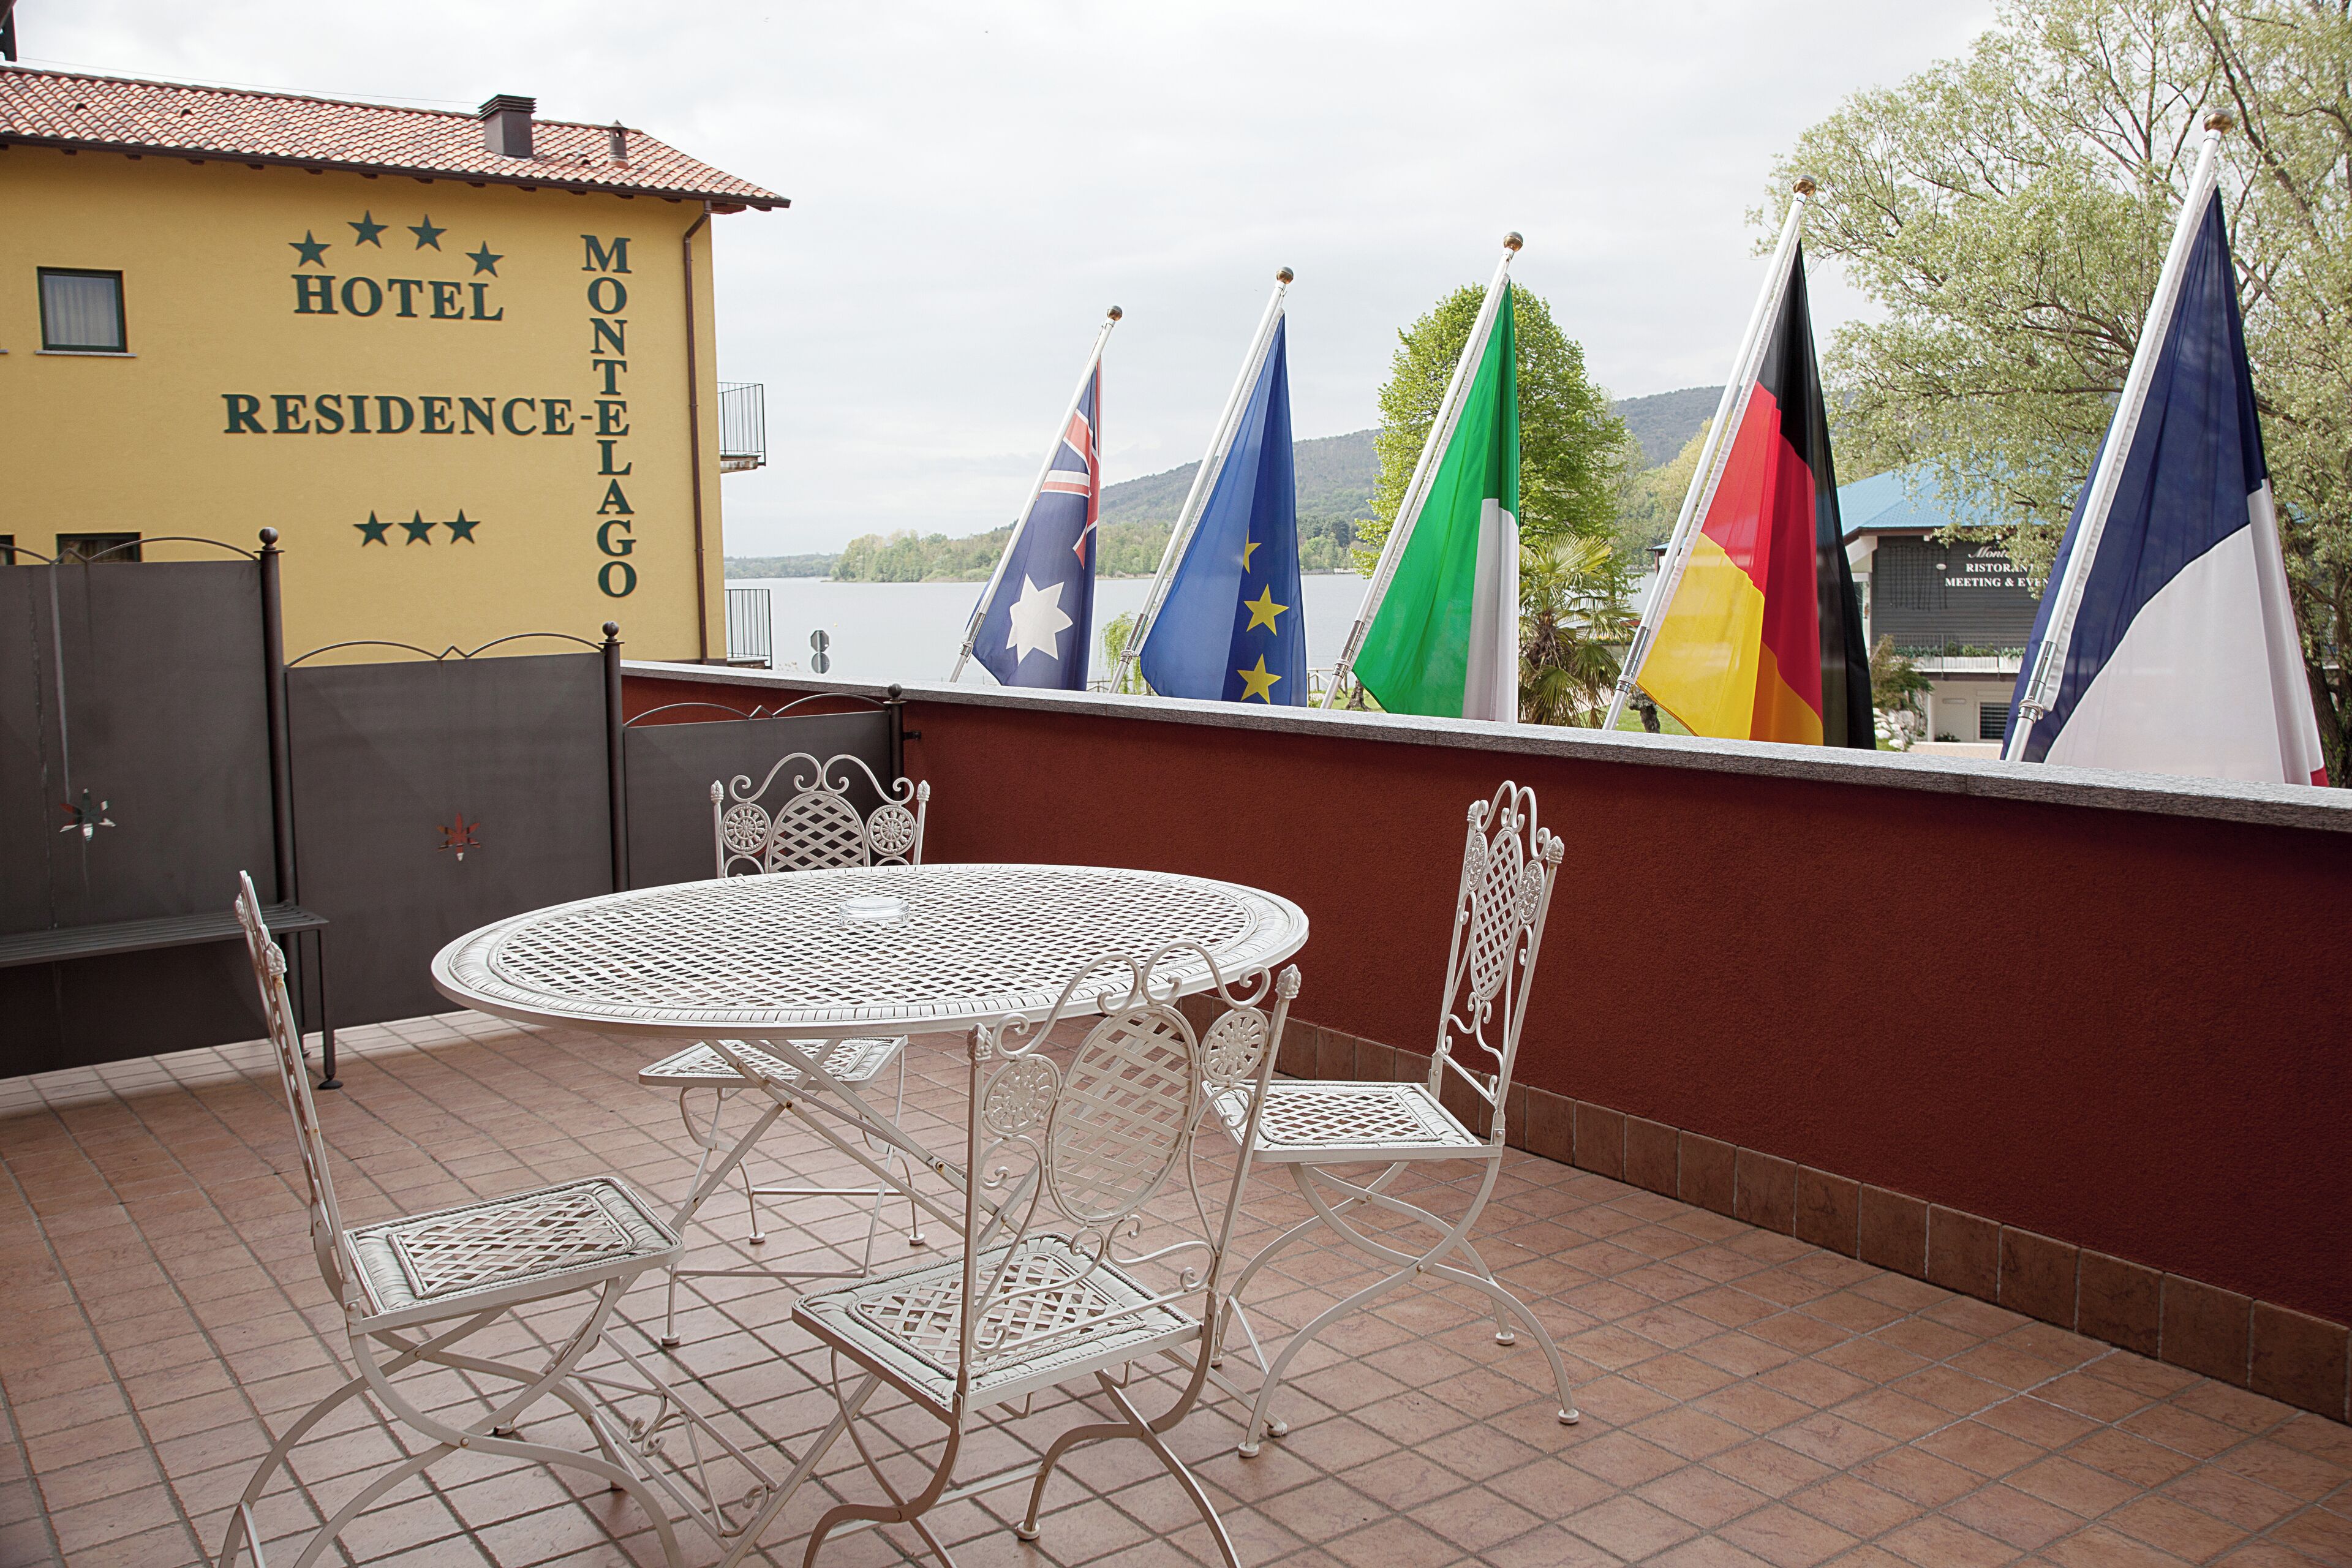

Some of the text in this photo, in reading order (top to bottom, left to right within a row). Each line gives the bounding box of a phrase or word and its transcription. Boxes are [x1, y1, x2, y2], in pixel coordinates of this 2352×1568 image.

[290, 274, 503, 321] HOTEL
[580, 234, 637, 598] MONTELAGO
[1966, 563, 2040, 573] RISTORANT
[1945, 578, 2049, 587] MEETING & EVEN
